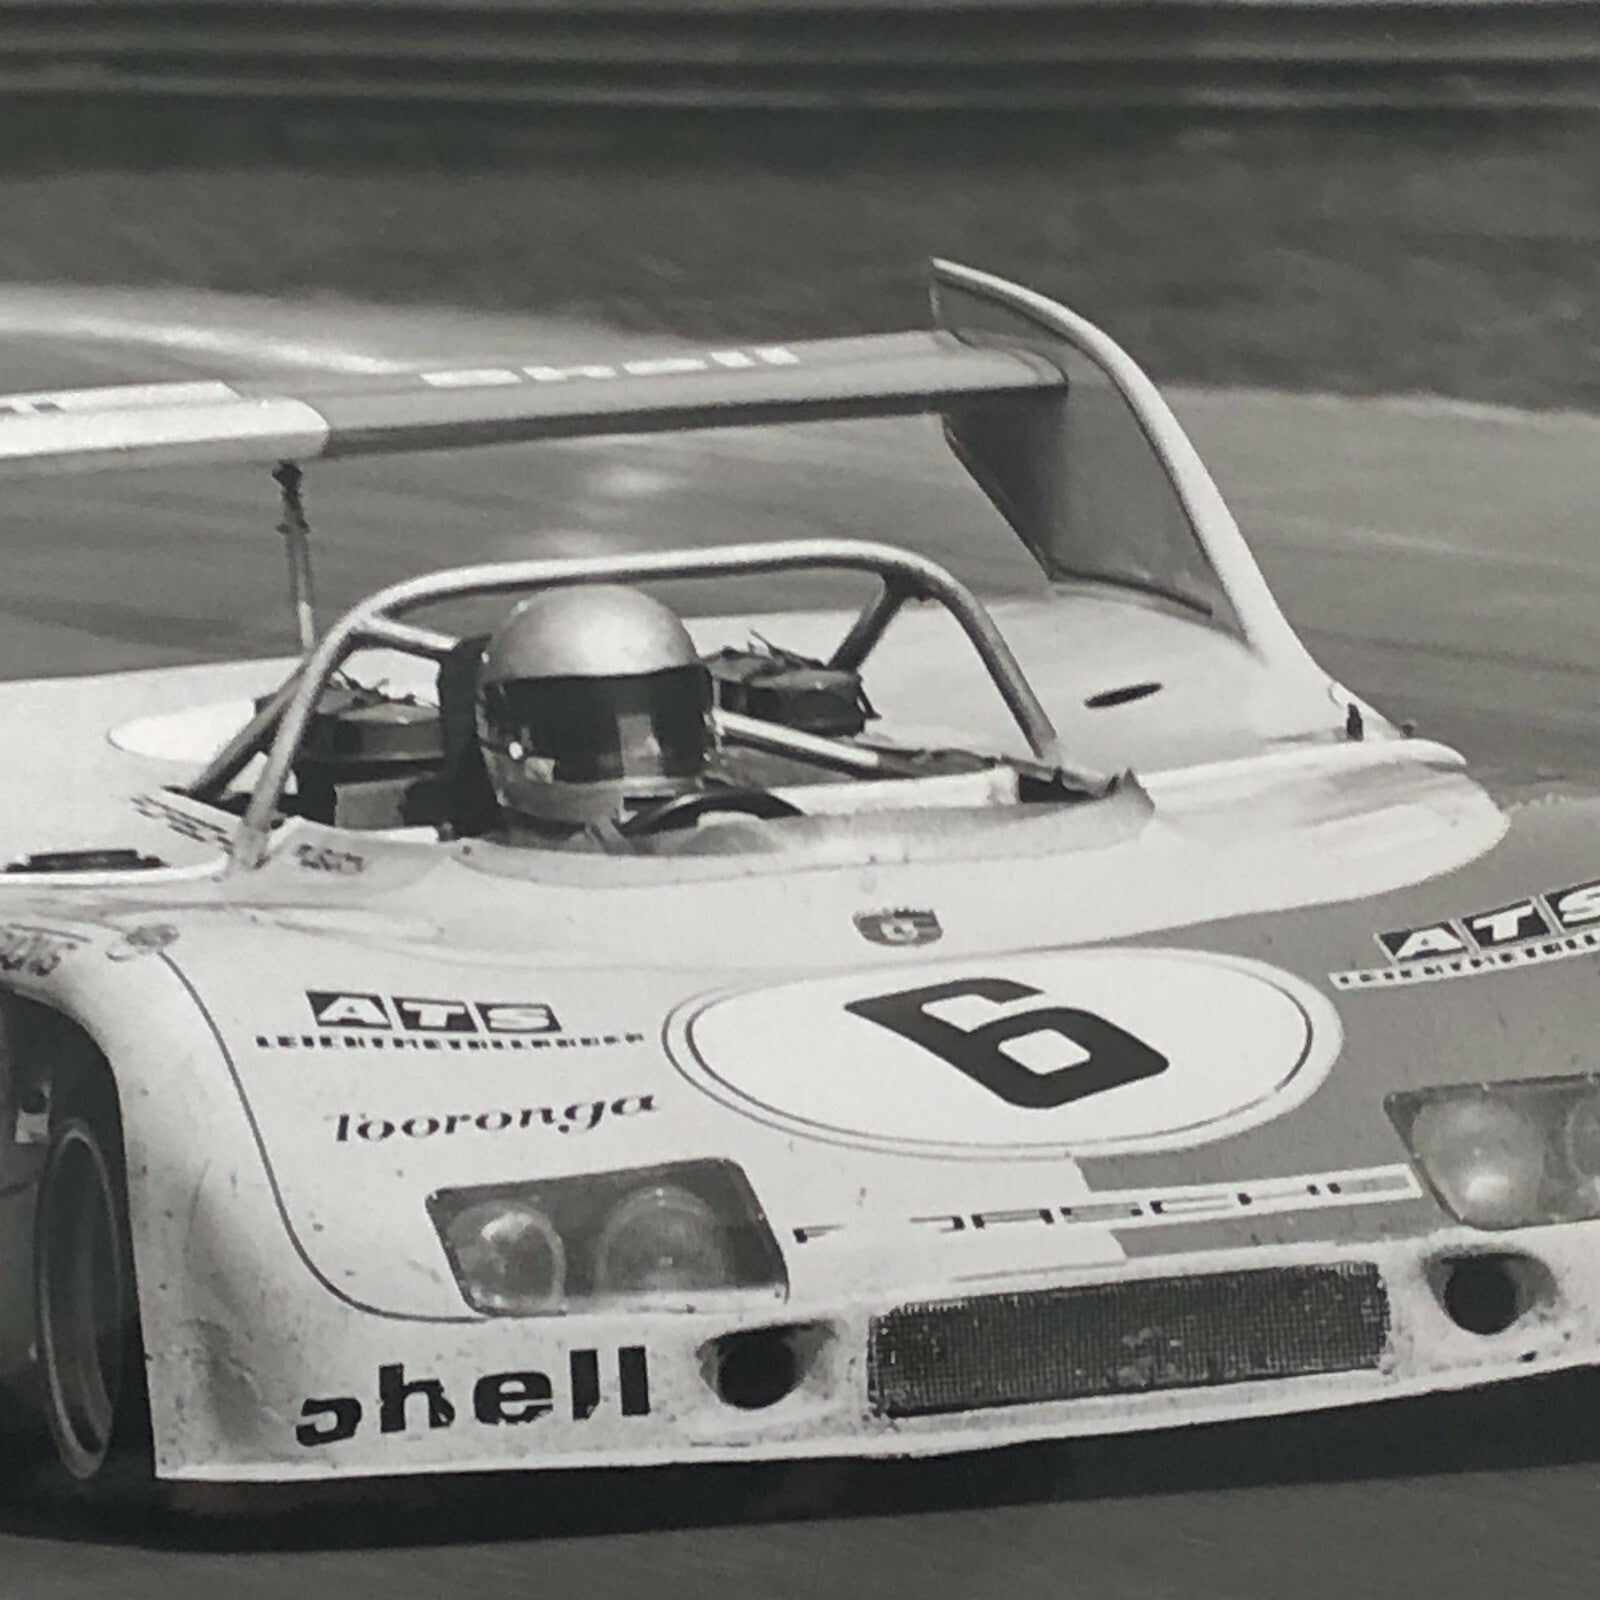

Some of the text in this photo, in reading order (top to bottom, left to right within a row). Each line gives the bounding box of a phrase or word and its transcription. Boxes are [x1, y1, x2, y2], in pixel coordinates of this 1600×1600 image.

[1394, 886, 1600, 957] ATS
[311, 992, 557, 1031] ATS
[845, 978, 1170, 1109] 6
[324, 1094, 657, 1142] Tooronga
[296, 1345, 651, 1447] shell
